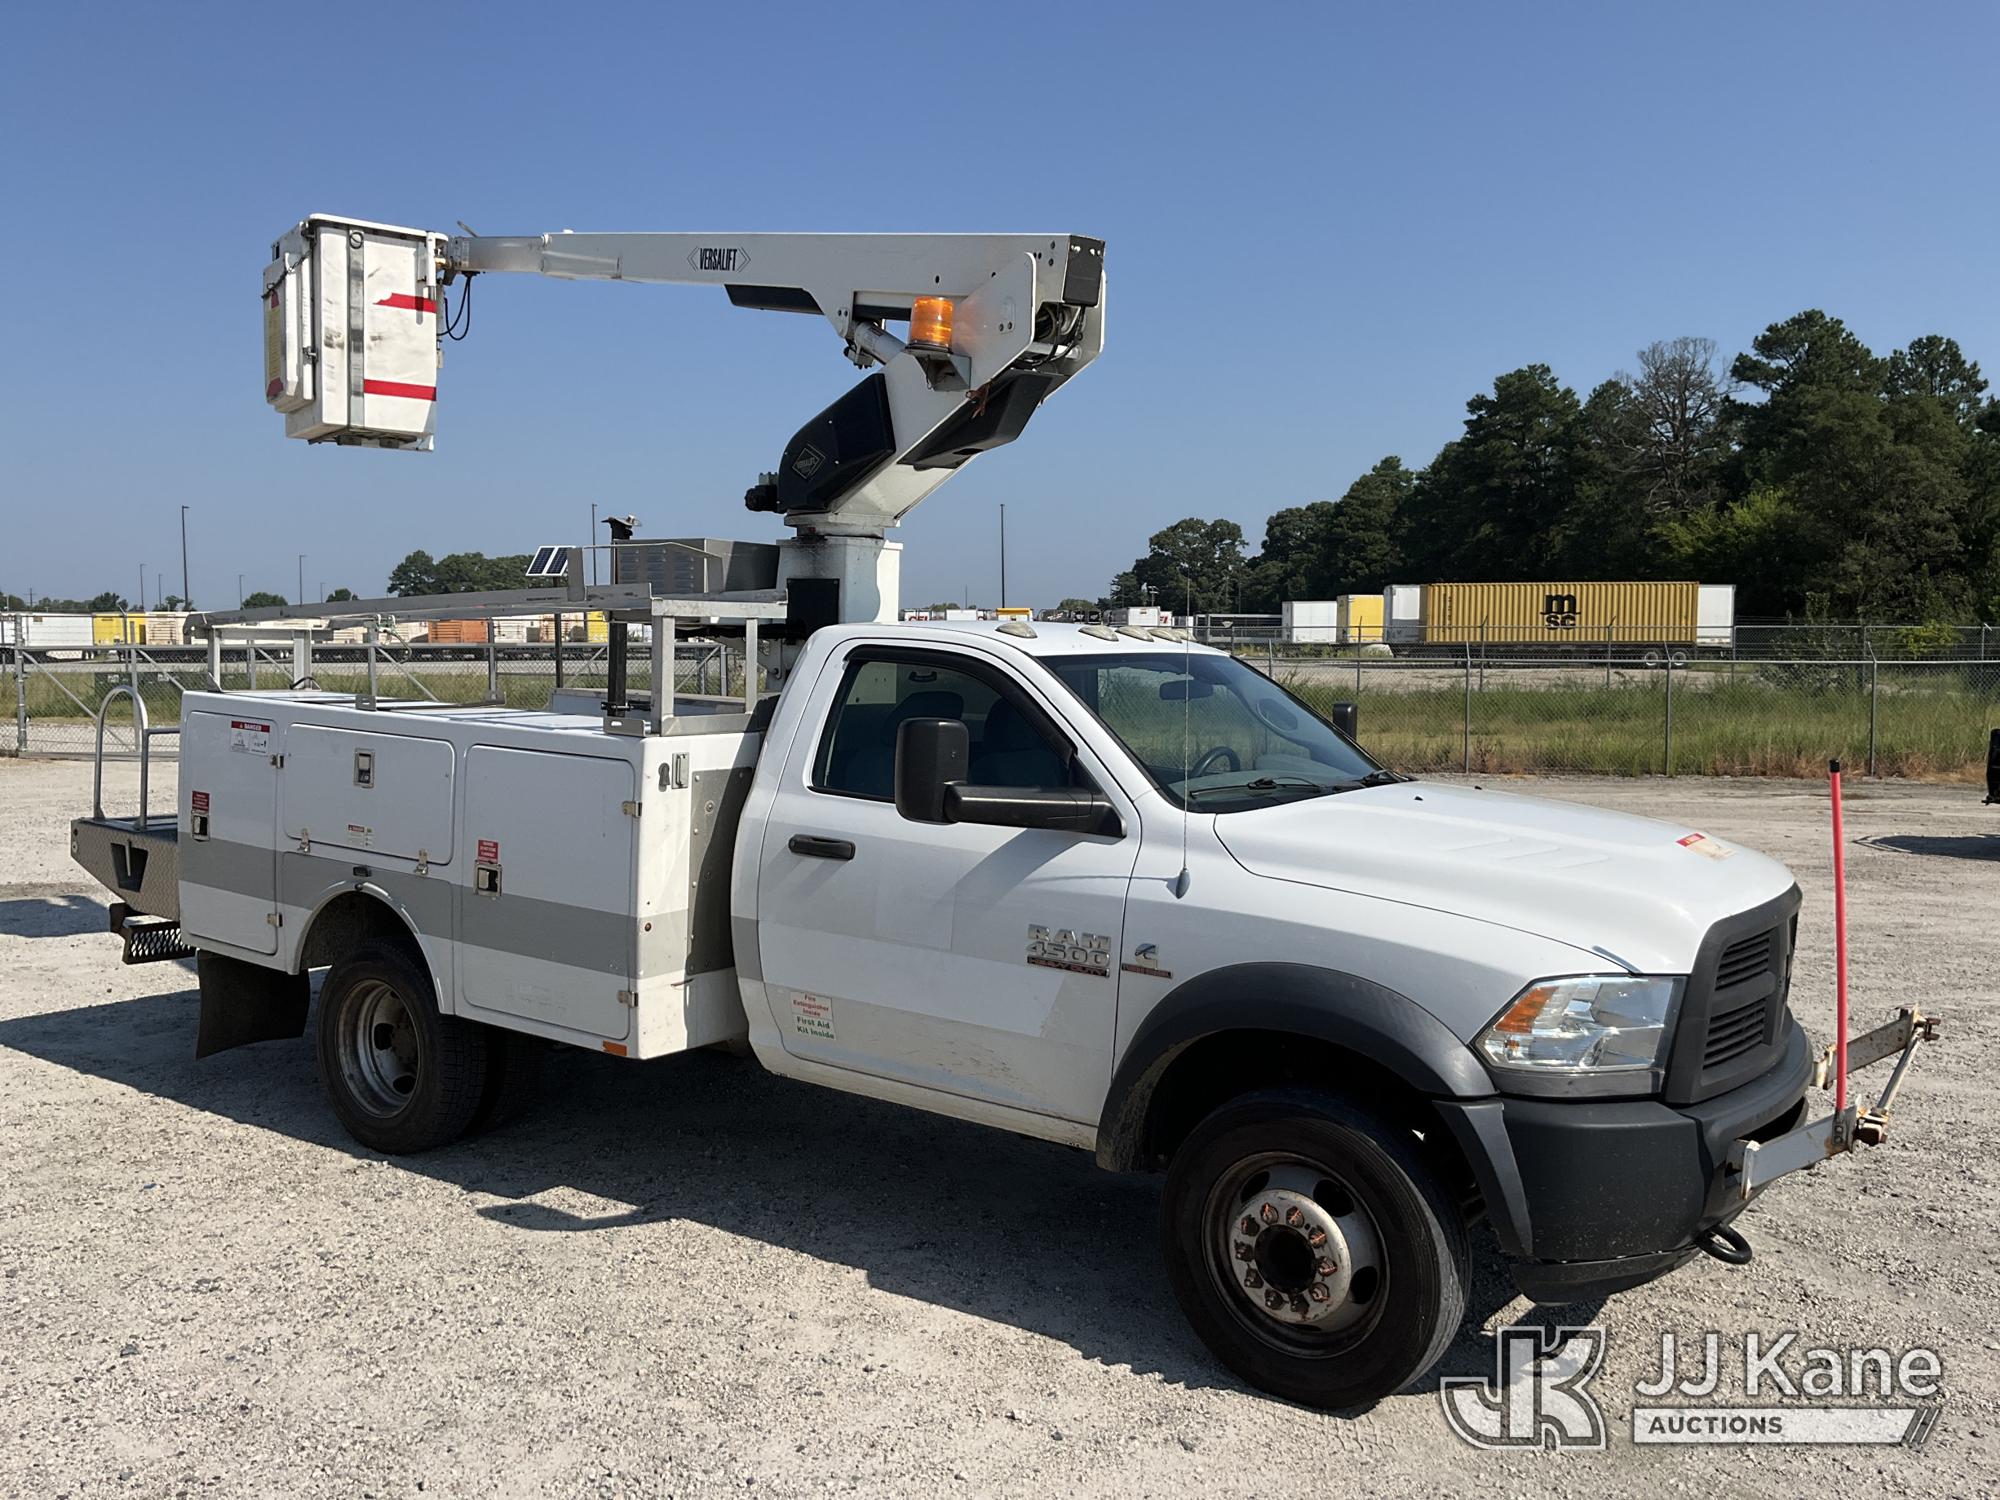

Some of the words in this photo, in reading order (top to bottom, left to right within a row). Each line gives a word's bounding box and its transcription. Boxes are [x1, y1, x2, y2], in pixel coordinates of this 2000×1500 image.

[699, 247, 738, 271] VERSALIFT
[1027, 923, 1111, 949] RAM
[1026, 940, 1110, 967] 4500
[797, 1016, 815, 1026] First
[817, 1020, 831, 1030] Aid
[797, 1026, 809, 1034] Kit
[810, 1028, 835, 1040] Inside
